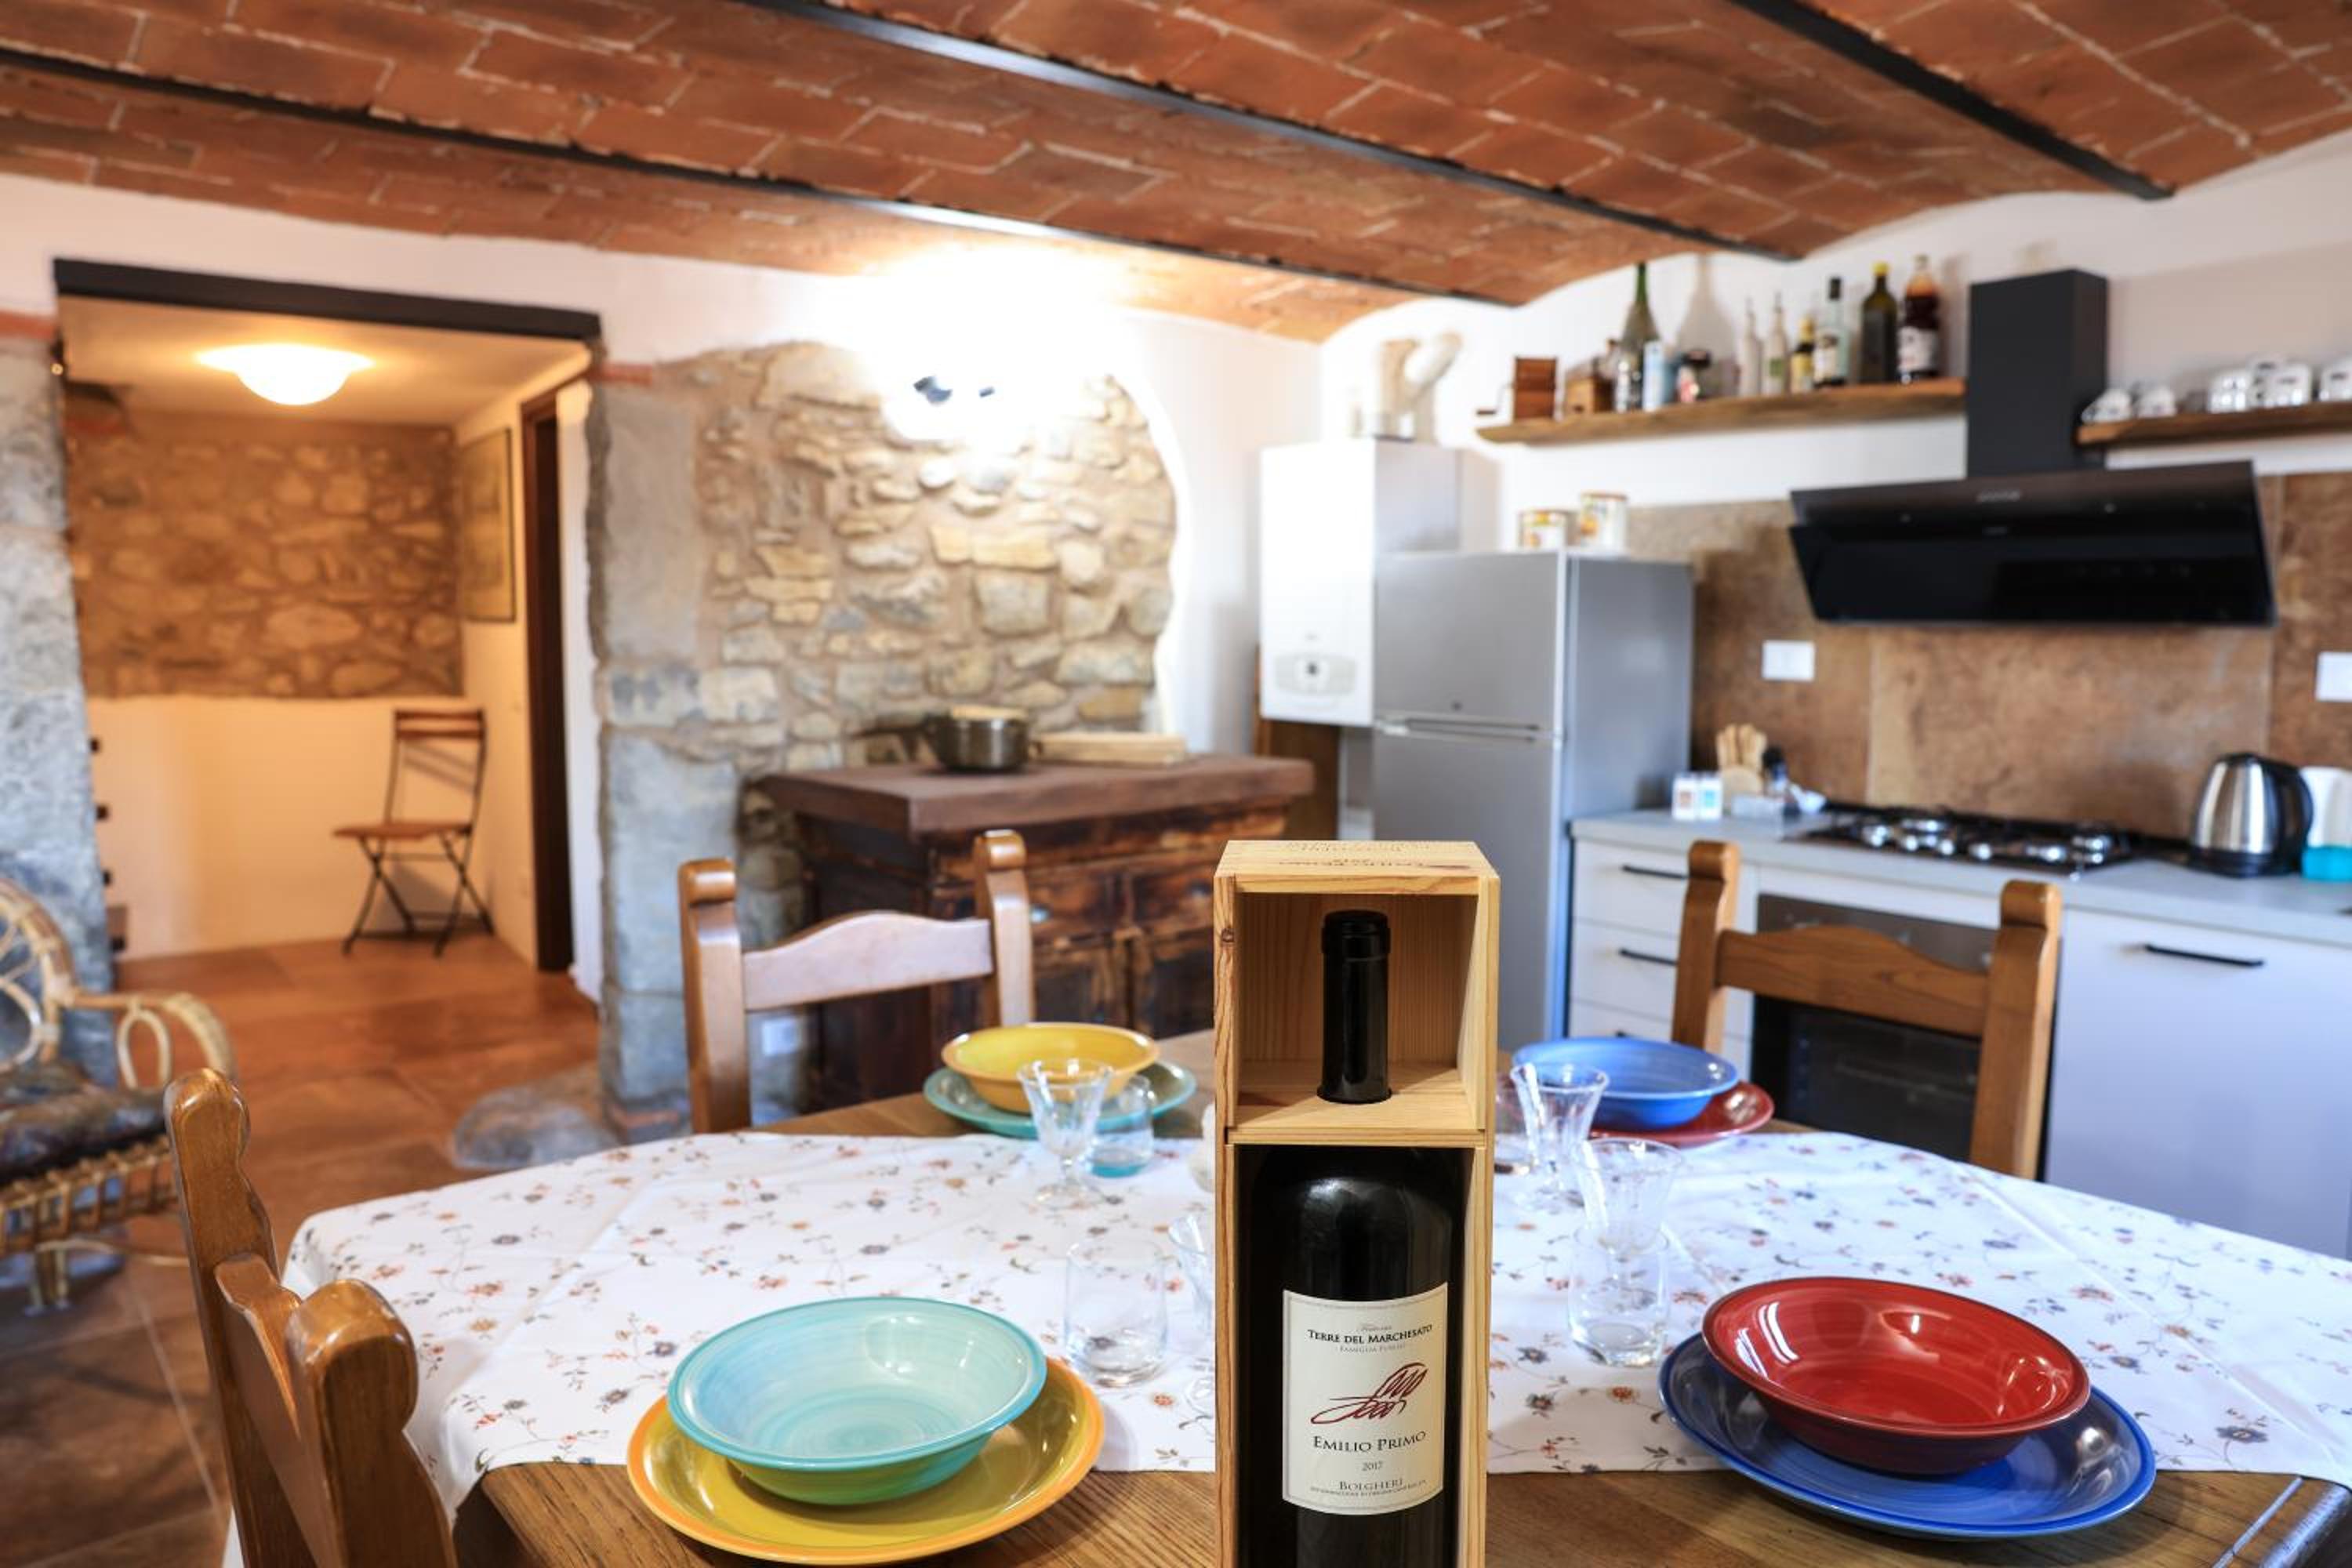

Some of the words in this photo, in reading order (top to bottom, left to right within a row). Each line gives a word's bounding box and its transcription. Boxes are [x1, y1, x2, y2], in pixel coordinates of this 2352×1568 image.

[1307, 1330, 1340, 1343] TERRE
[1344, 1335, 1364, 1344] DEL
[1368, 1324, 1433, 1343] MARCHESATO
[1313, 1436, 1372, 1451] EMILIO
[1377, 1431, 1427, 1451] PRIMO
[1362, 1461, 1383, 1471] 2017
[1339, 1478, 1403, 1490] BOLGHERI
